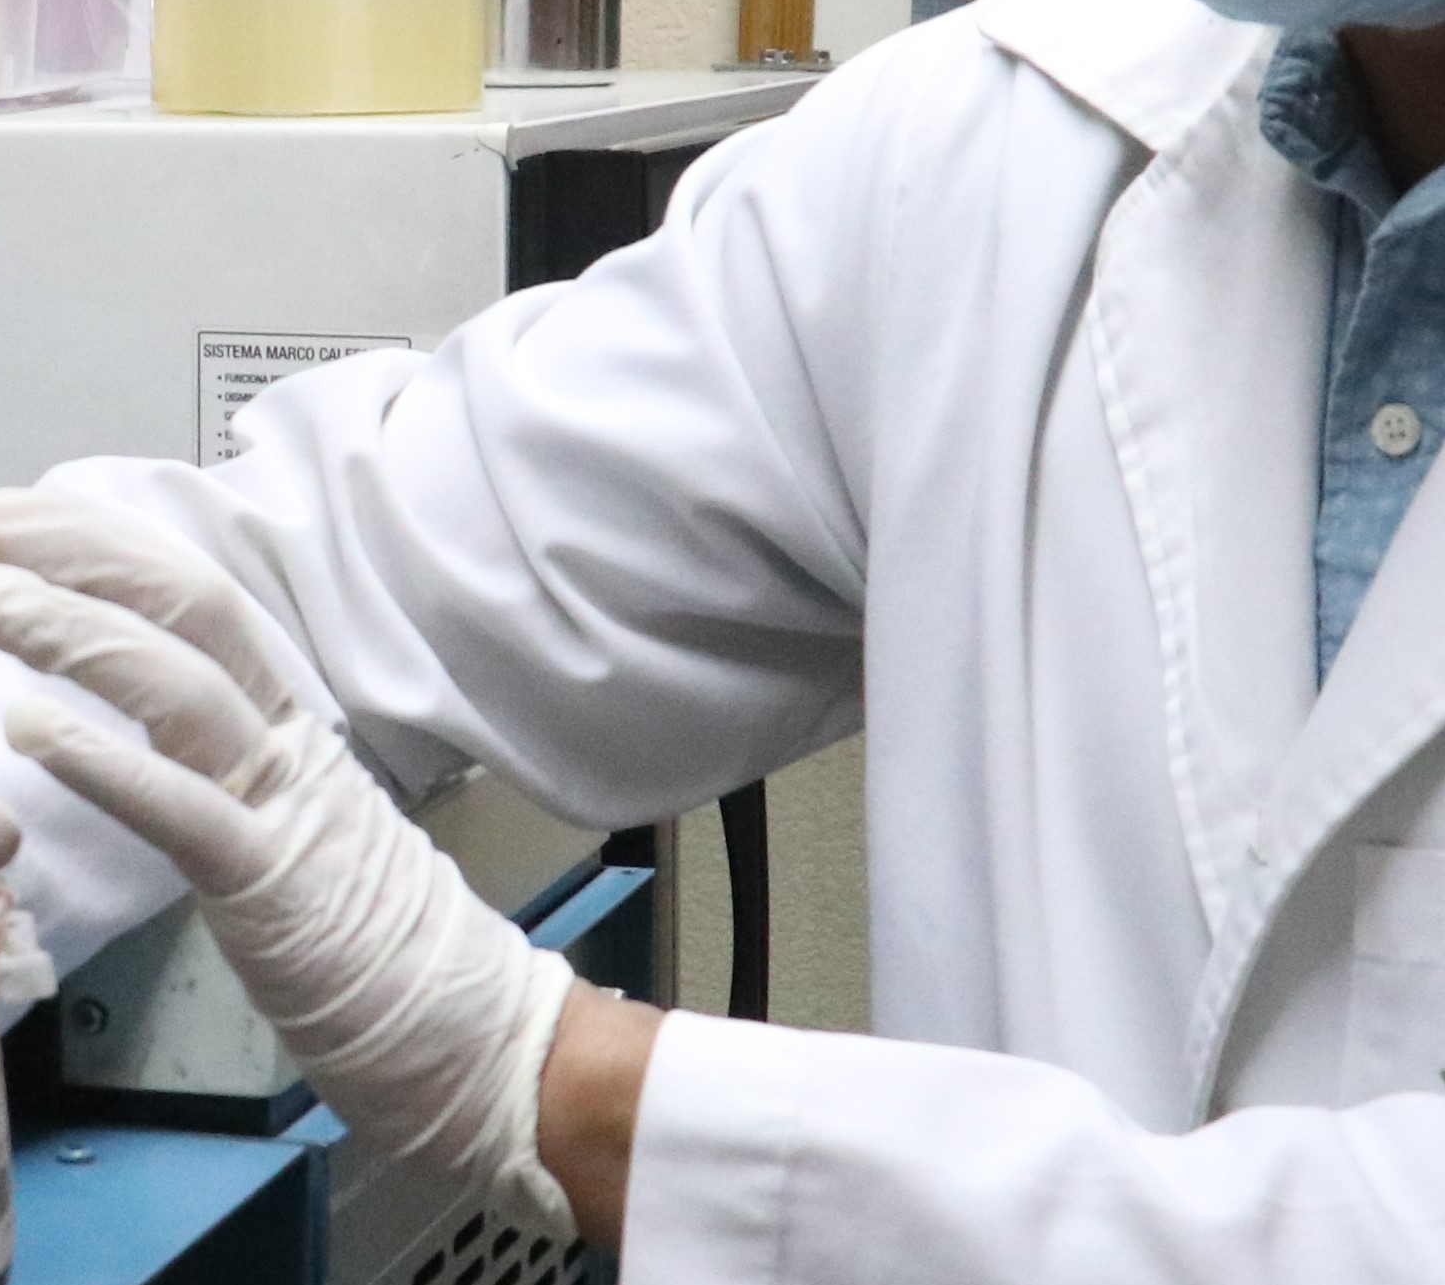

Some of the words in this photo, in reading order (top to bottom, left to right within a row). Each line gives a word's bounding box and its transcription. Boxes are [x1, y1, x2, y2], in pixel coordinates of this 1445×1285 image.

[203, 343, 262, 360] SISTEMA
[266, 345, 315, 361] MARCO
[224, 373, 268, 384] FUNCIONA
